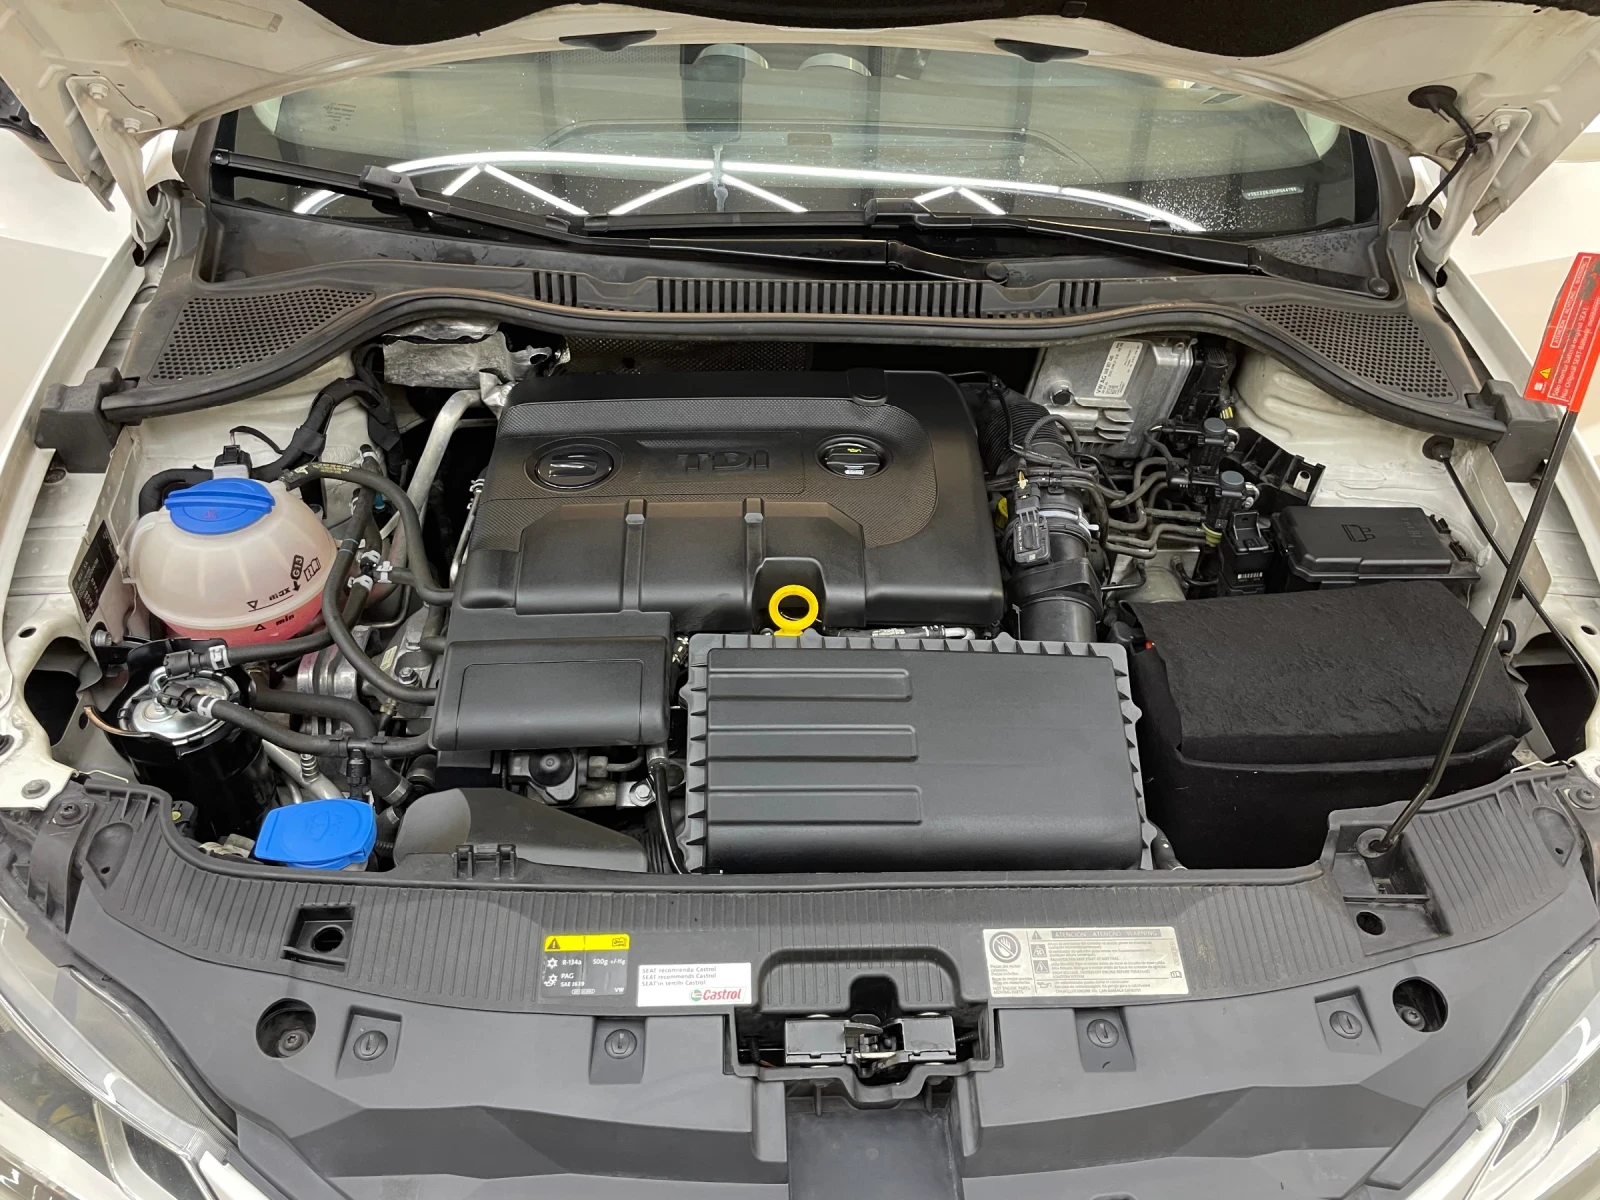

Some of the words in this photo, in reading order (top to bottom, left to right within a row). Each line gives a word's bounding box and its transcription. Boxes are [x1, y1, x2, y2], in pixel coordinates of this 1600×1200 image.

[677, 449, 770, 471] TDI
[292, 557, 302, 576] G13
[269, 587, 291, 601] max
[276, 614, 294, 626] min
[703, 988, 742, 1000] Castrol
